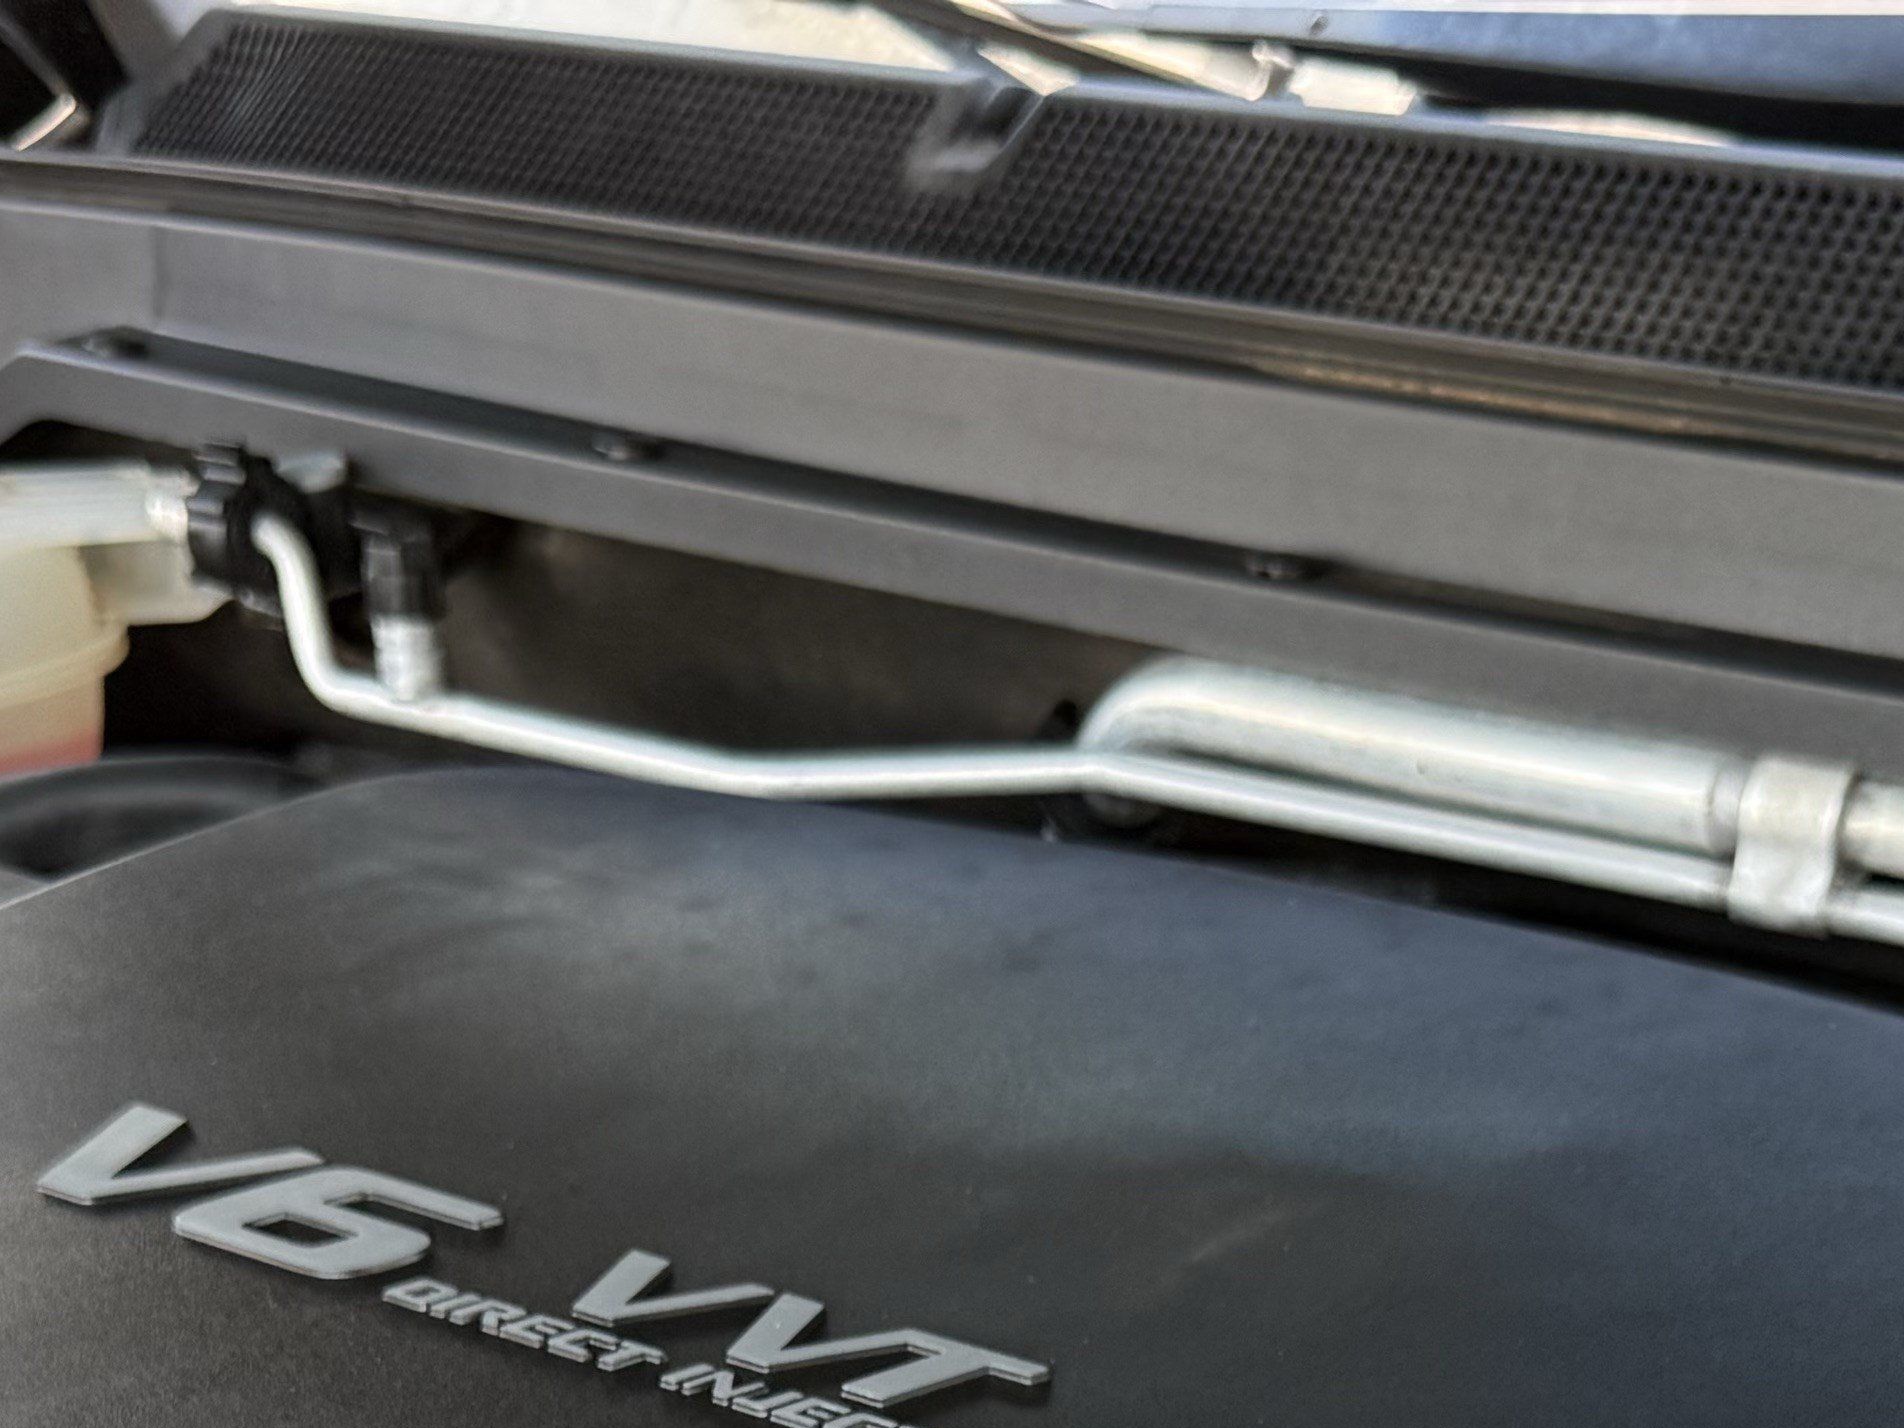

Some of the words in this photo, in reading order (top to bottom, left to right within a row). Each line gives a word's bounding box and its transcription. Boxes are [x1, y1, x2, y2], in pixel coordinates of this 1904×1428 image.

[37, 1104, 503, 1280] V6
[571, 1250, 1050, 1408] VVT
[383, 1278, 666, 1372] DIRECT
